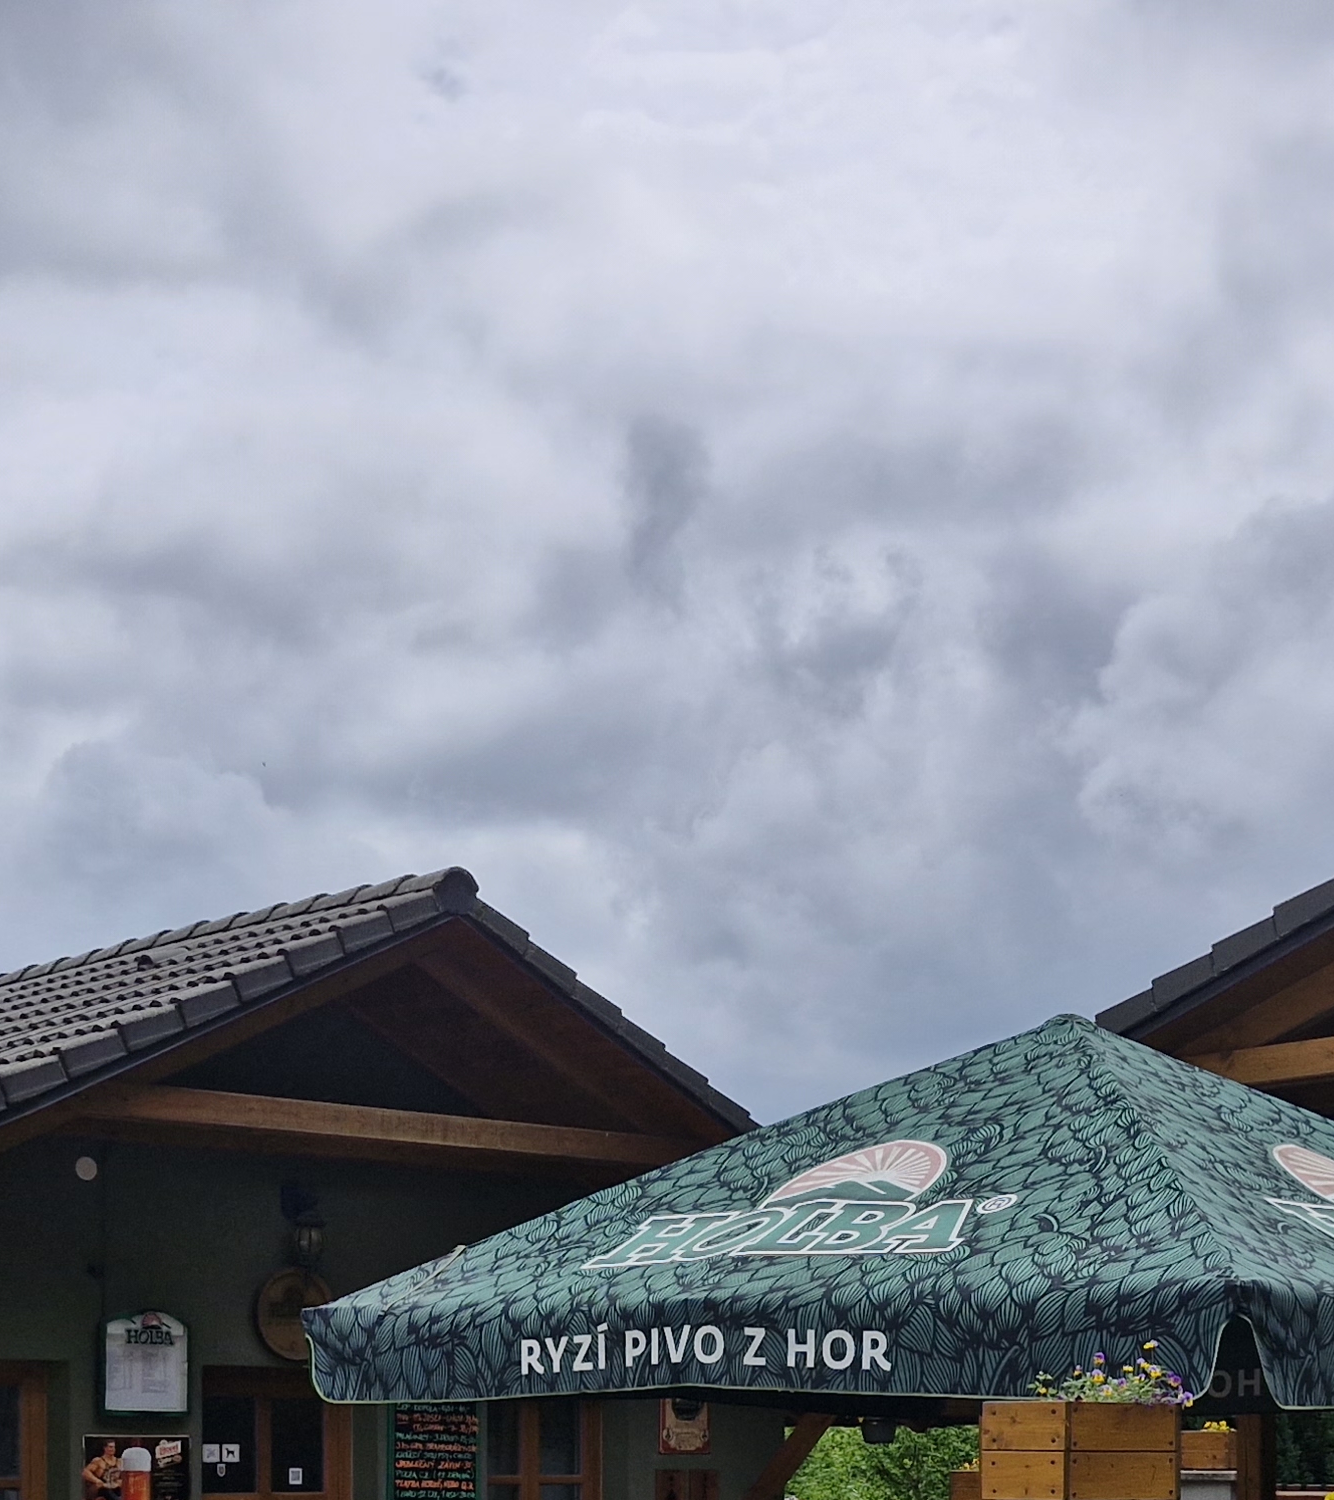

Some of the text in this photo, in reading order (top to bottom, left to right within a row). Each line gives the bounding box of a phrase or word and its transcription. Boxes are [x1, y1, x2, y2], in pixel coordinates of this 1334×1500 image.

[580, 1198, 974, 1270] HOLBA
[125, 1328, 174, 1346] HOLBA
[520, 1322, 893, 1376] RYZÍ PIVO Z HOR
